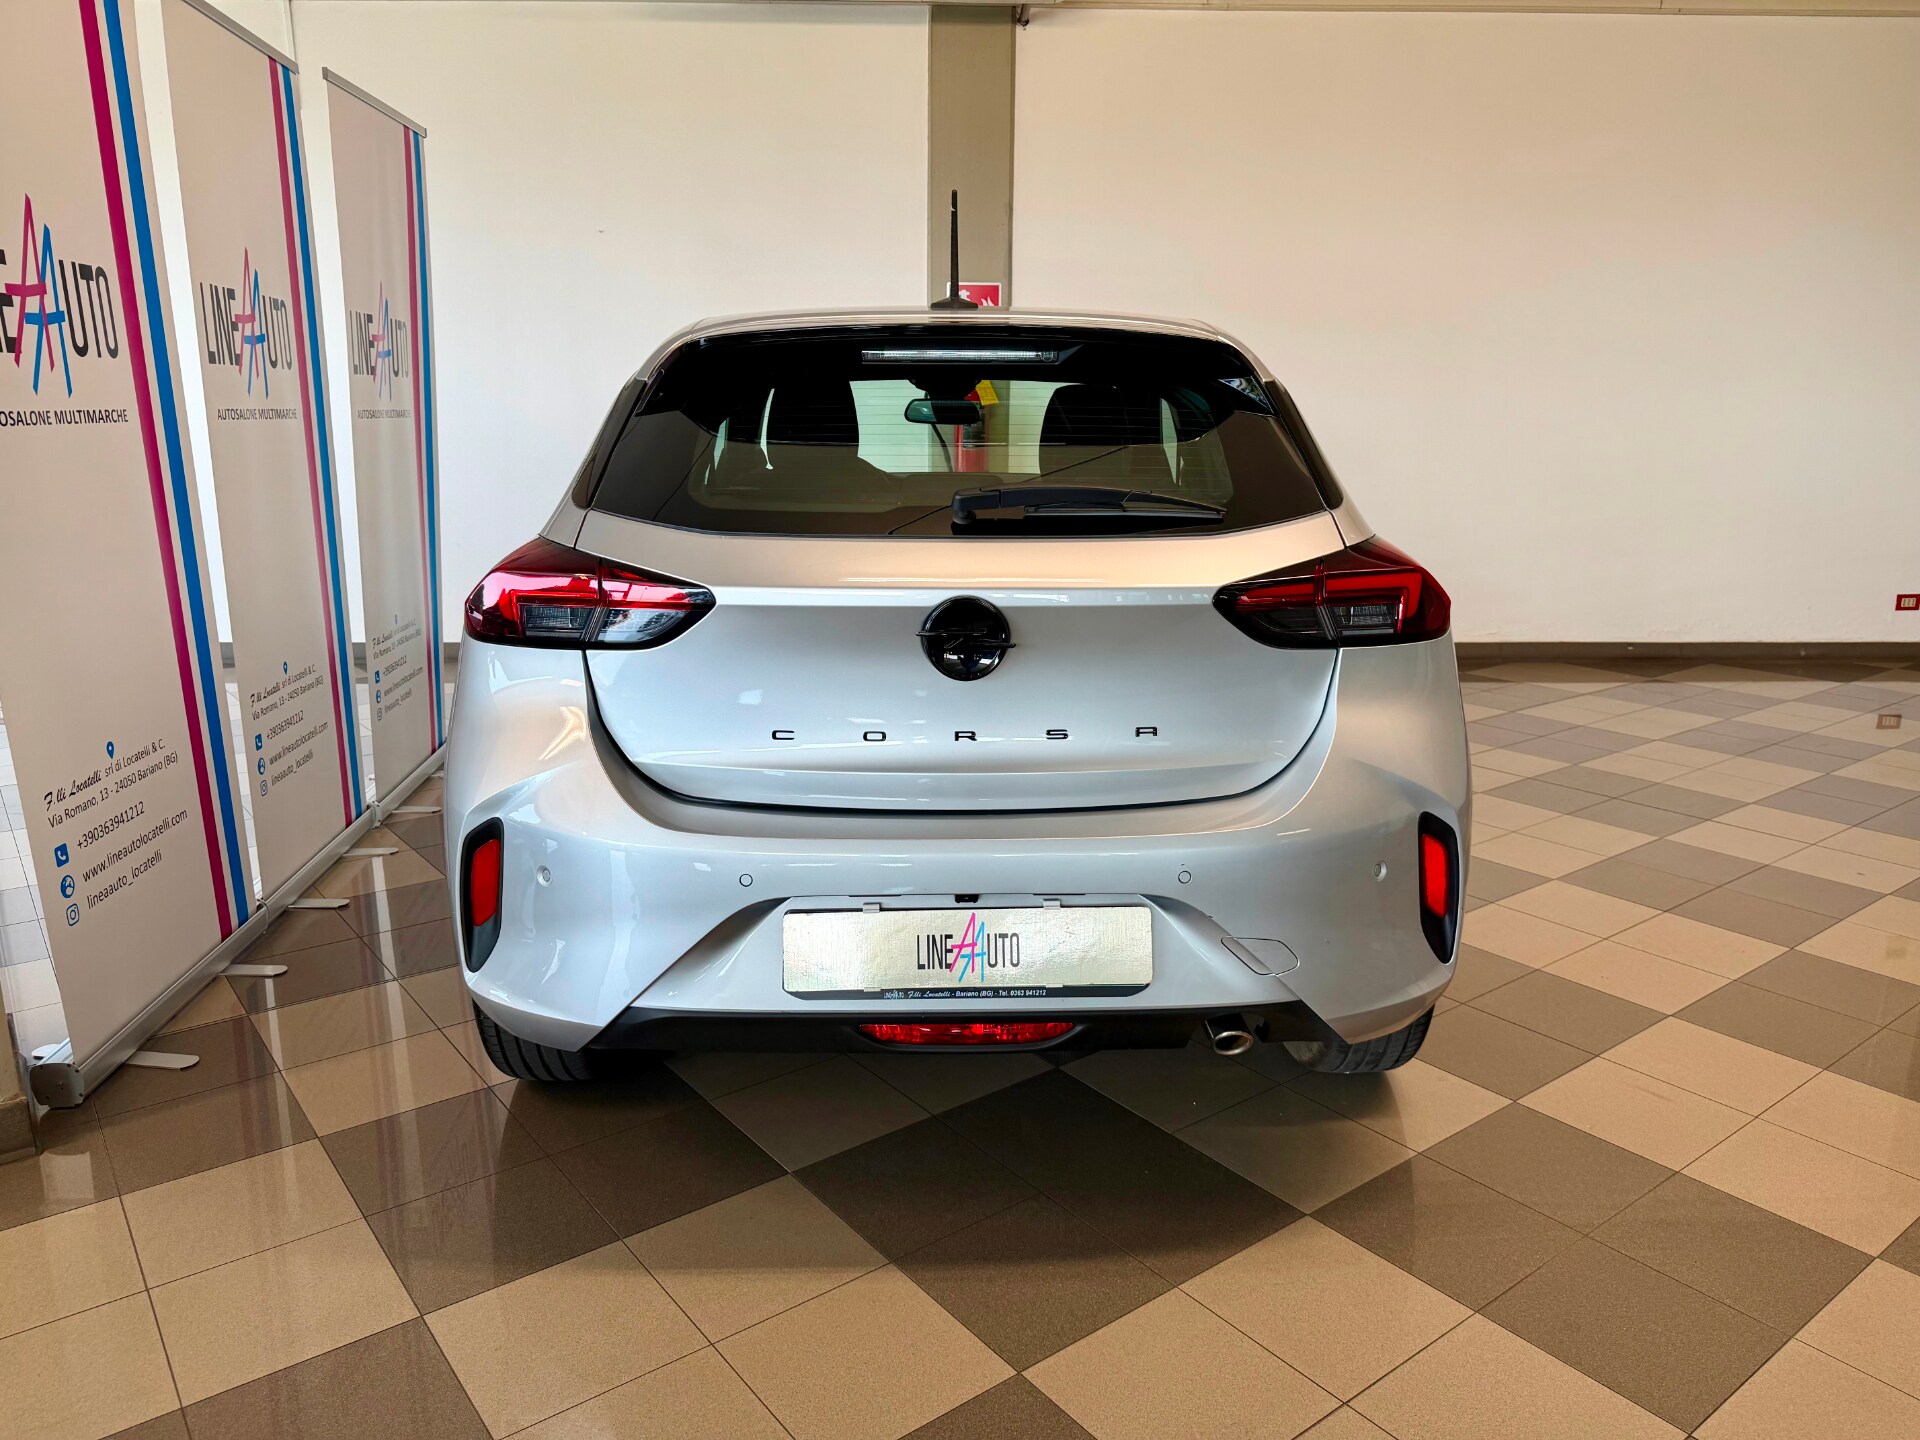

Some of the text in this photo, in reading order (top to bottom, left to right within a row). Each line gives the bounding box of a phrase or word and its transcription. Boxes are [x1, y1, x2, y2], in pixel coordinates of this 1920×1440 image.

[54, 409, 129, 425] MULTIMARCHE
[217, 408, 258, 421] AUTOSALONE
[771, 726, 1158, 742] CORSA
[43, 738, 166, 812] F.lli Locatelli srl di Locatelli & C.
[47, 814, 64, 828] Via
[64, 796, 99, 821] Romano,
[99, 787, 110, 802] 13
[114, 772, 137, 794] 24050
[137, 760, 163, 781] Bariano
[163, 750, 179, 769] (BG)
[76, 800, 145, 850] +390363941212
[82, 809, 188, 883] www.lineautolocatelli.com
[86, 848, 162, 910] lineaauto_locatelli
[980, 989, 994, 997] (BG)
